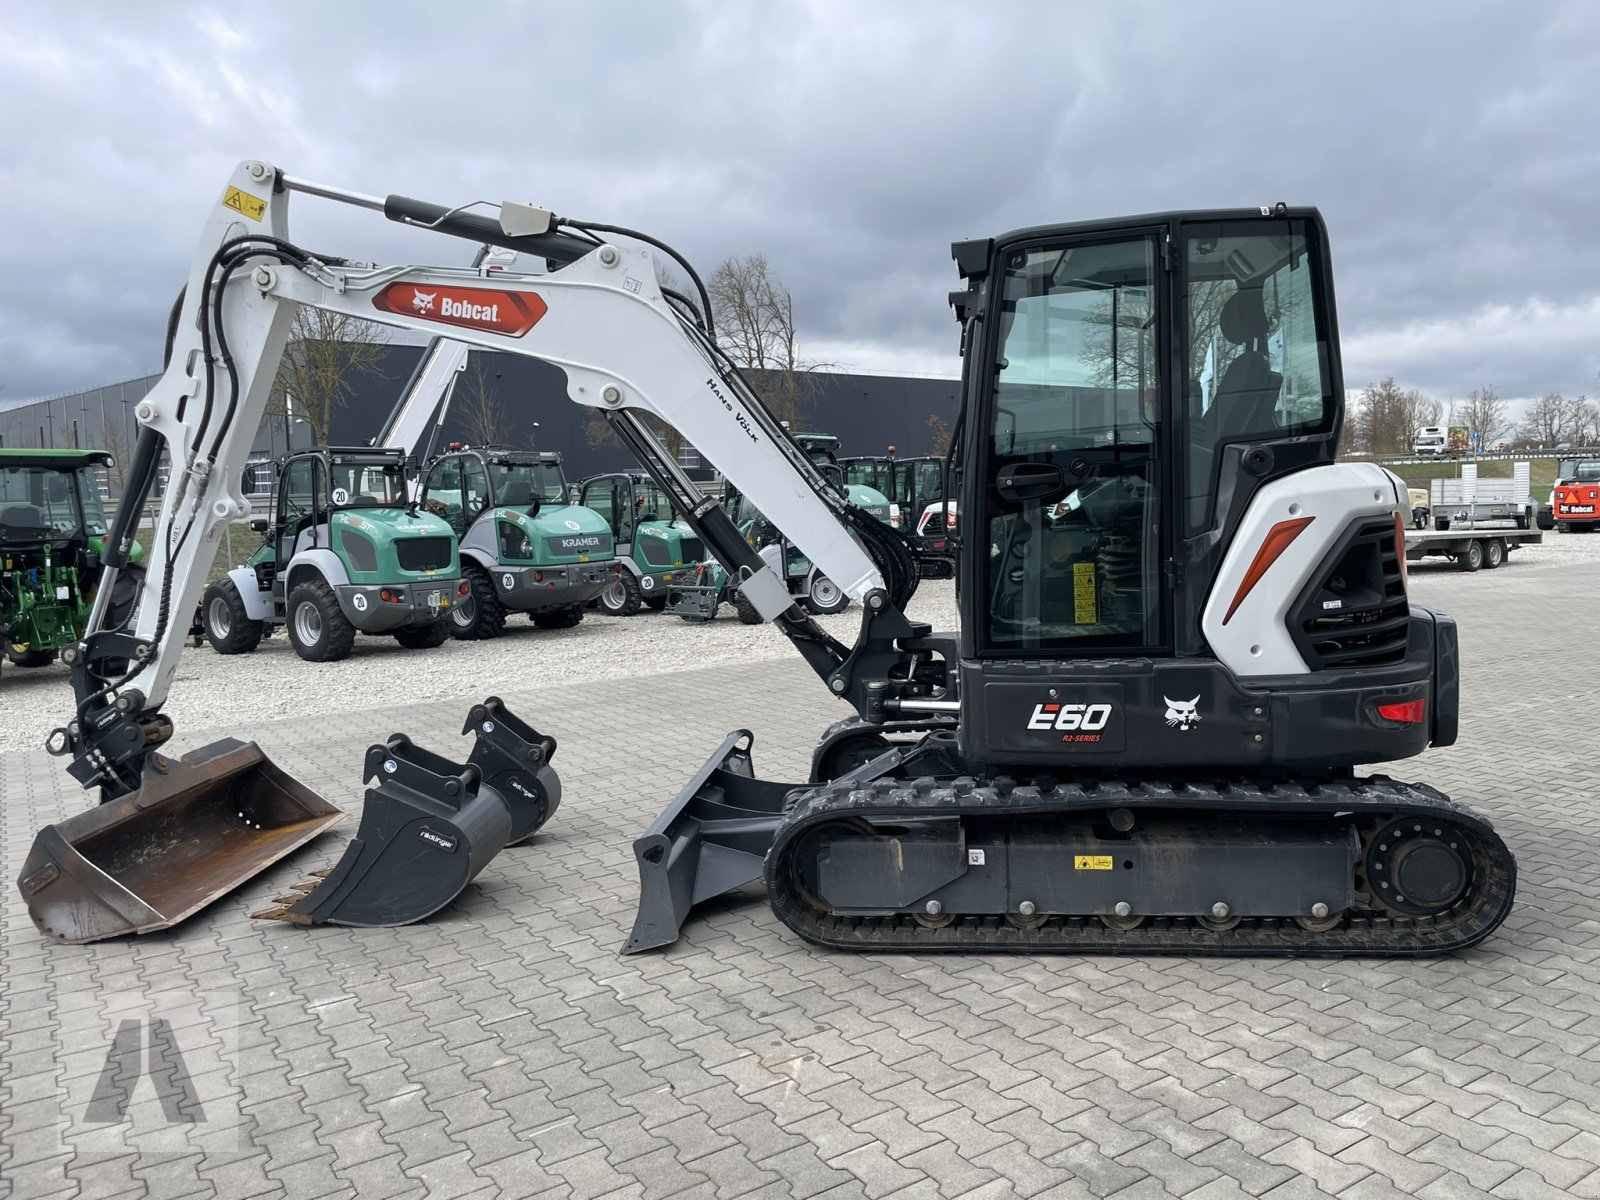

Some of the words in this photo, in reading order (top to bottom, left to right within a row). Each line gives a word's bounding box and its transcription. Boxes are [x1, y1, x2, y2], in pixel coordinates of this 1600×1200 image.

[441, 297, 498, 323] Bobcat
[336, 491, 345, 503] 20
[1570, 505, 1593, 513] Bobcat
[561, 537, 600, 548] KRAMER
[505, 575, 513, 587] 20
[643, 578, 652, 588] 20
[357, 597, 365, 608] 20
[1027, 703, 1113, 731] E60
[1062, 734, 1101, 743] R2-SERIES
